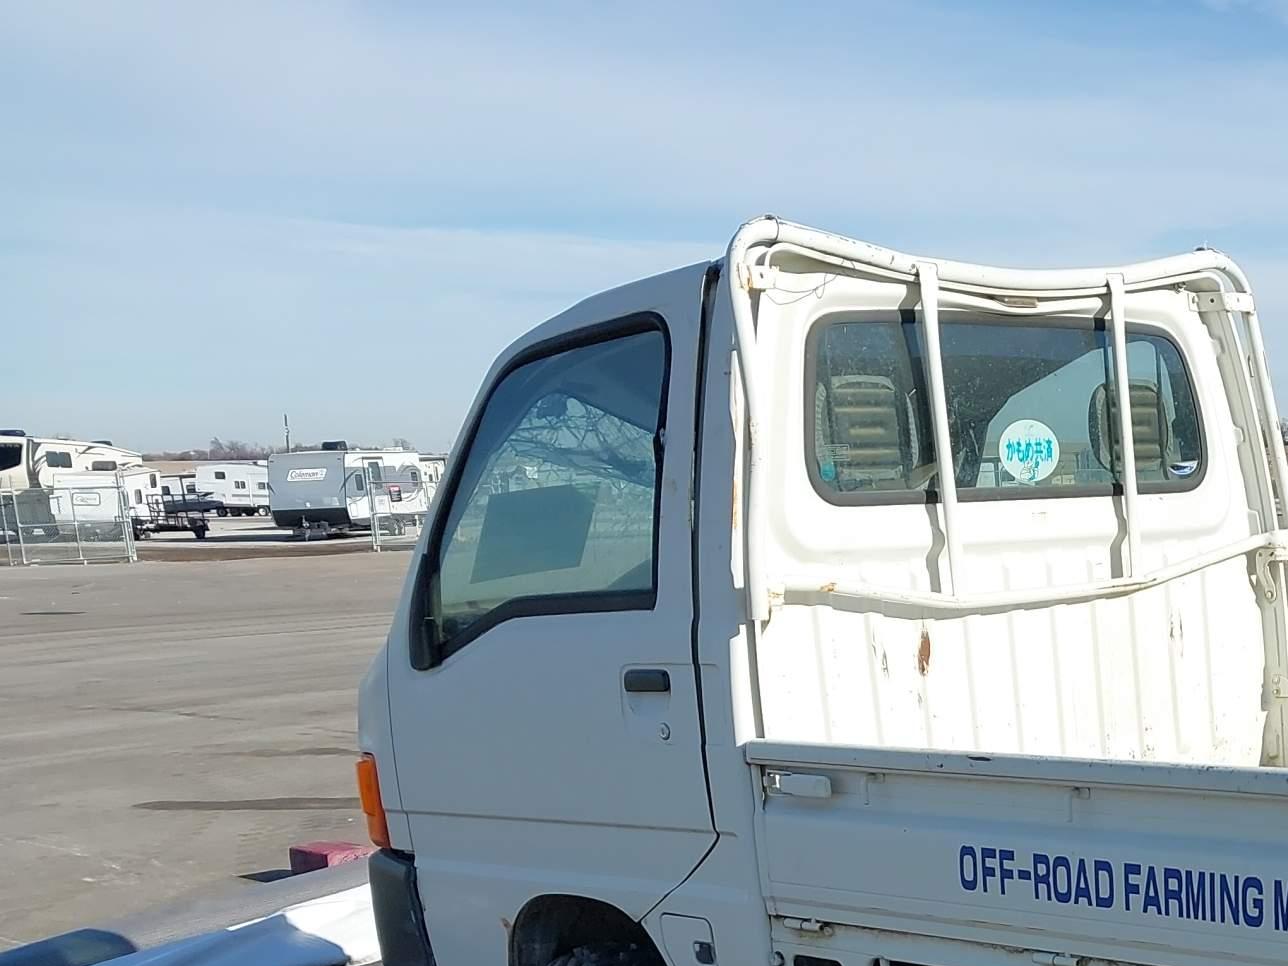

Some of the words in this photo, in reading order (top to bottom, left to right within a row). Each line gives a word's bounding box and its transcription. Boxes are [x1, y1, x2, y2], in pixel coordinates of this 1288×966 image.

[1005, 438, 1053, 462] かもめ共済
[959, 845, 1114, 909] OFF-ROAD
[1123, 862, 1264, 928] FARMING
